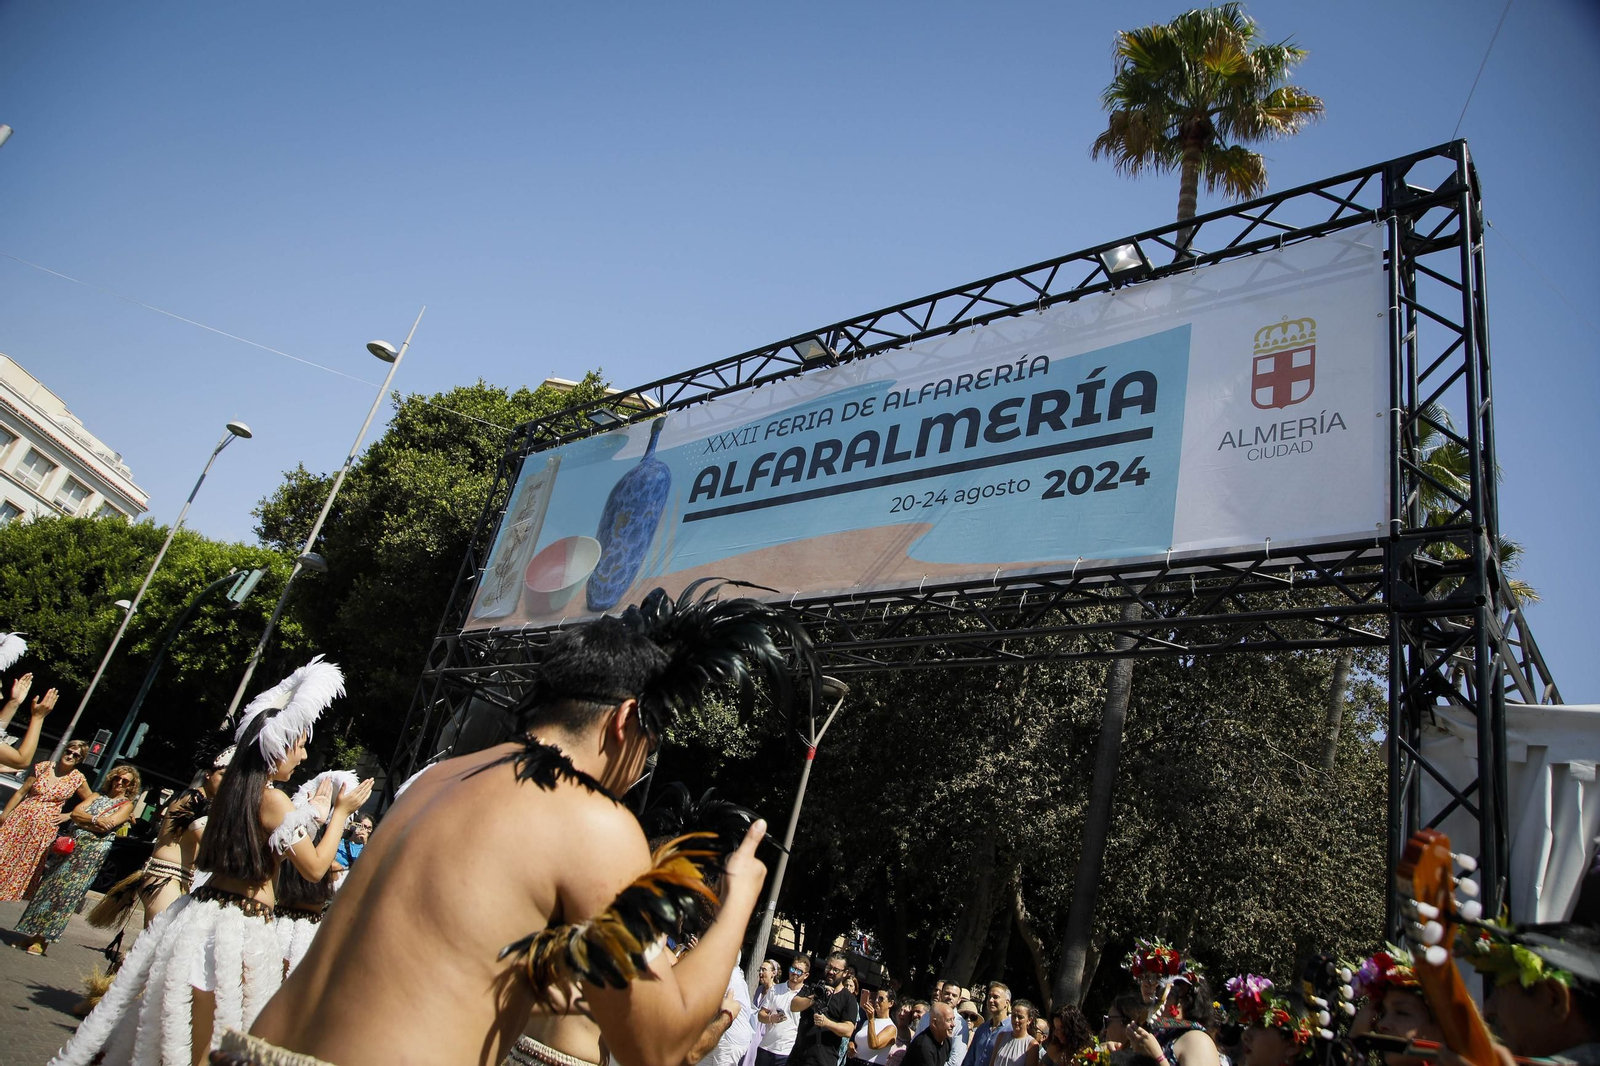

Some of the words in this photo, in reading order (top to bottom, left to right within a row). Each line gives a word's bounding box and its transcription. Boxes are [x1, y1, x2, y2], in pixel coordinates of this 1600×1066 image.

[703, 425, 759, 455] XXXII
[763, 409, 834, 441] FERIA
[840, 397, 878, 423] DE
[882, 354, 1050, 413] ALFARERÍA
[1218, 409, 1347, 451] ALMERÍA
[1247, 440, 1314, 461] CIUDAD
[889, 490, 949, 514] 20-24
[953, 476, 1031, 506] agosto
[1041, 456, 1151, 501] 2024
